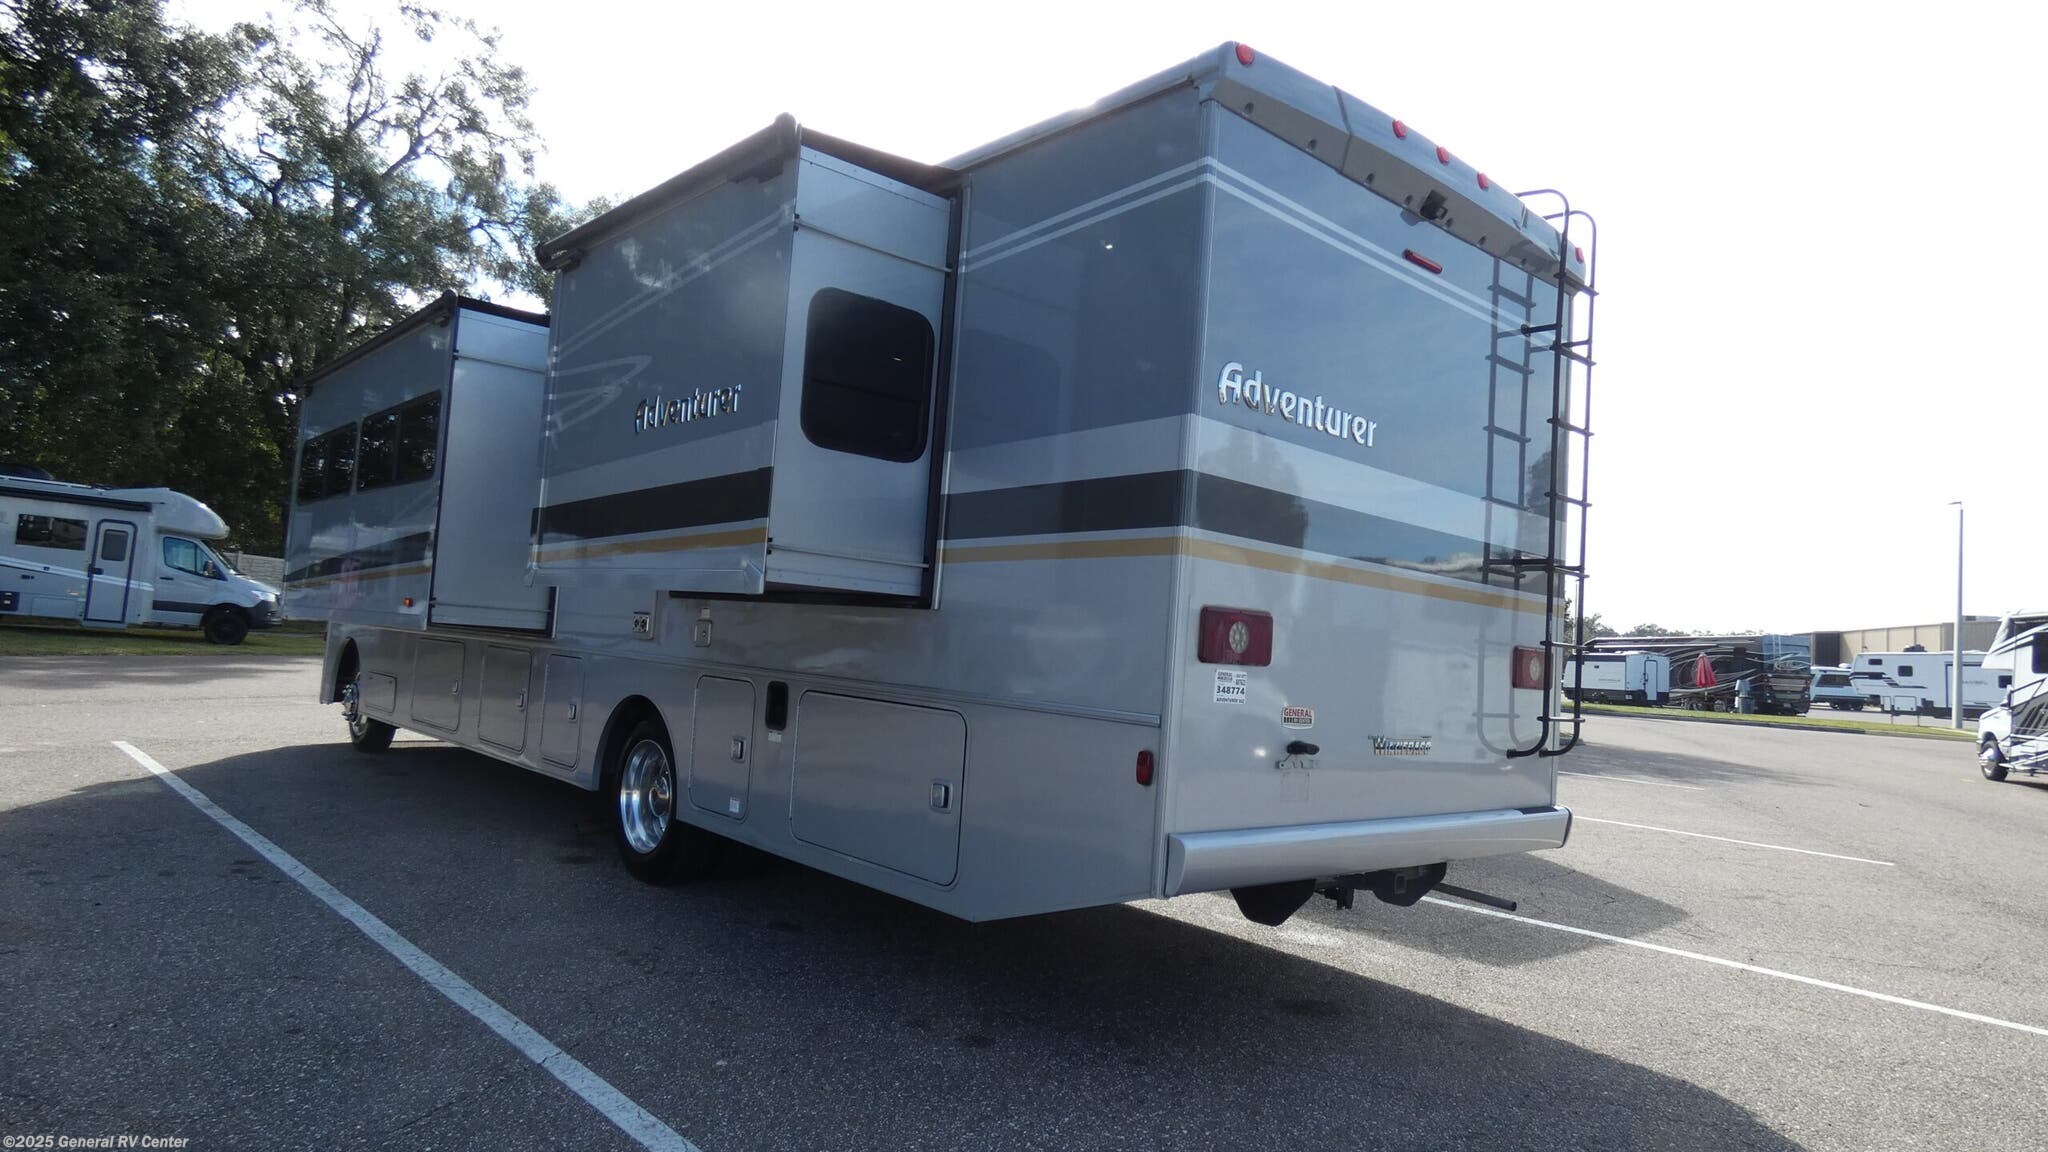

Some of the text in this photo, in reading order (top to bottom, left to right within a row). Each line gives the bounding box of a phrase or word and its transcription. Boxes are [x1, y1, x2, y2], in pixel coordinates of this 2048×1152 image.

[635, 383, 742, 433] Adventurer
[1218, 361, 1377, 447] Adventurer
[1216, 685, 1245, 695] 348774
[1283, 707, 1313, 717] GENERAL
